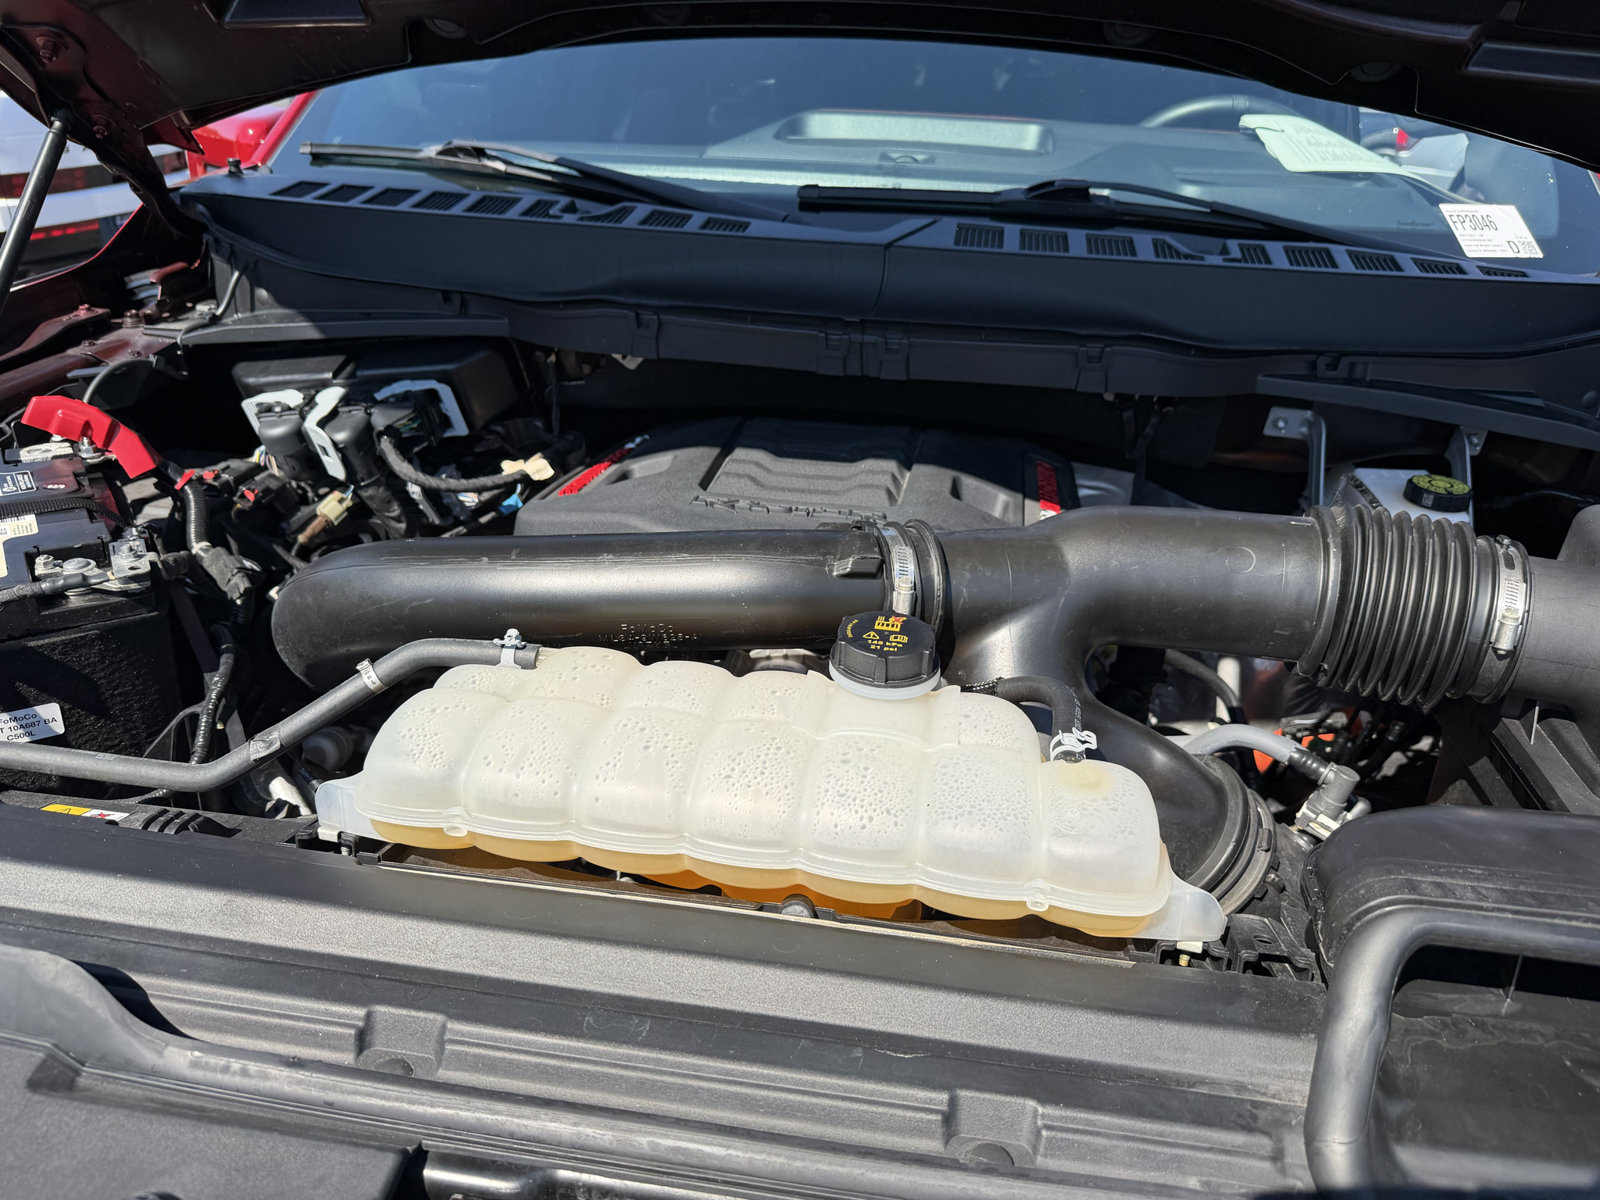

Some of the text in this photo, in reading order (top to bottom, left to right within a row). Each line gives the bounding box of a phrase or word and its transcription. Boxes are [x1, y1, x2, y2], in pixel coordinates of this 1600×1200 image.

[1448, 214, 1498, 231] FP3046
[1507, 240, 1520, 253] D
[8, 720, 41, 732] 10A687
[43, 717, 58, 725] BA
[6, 730, 37, 741] C500L
